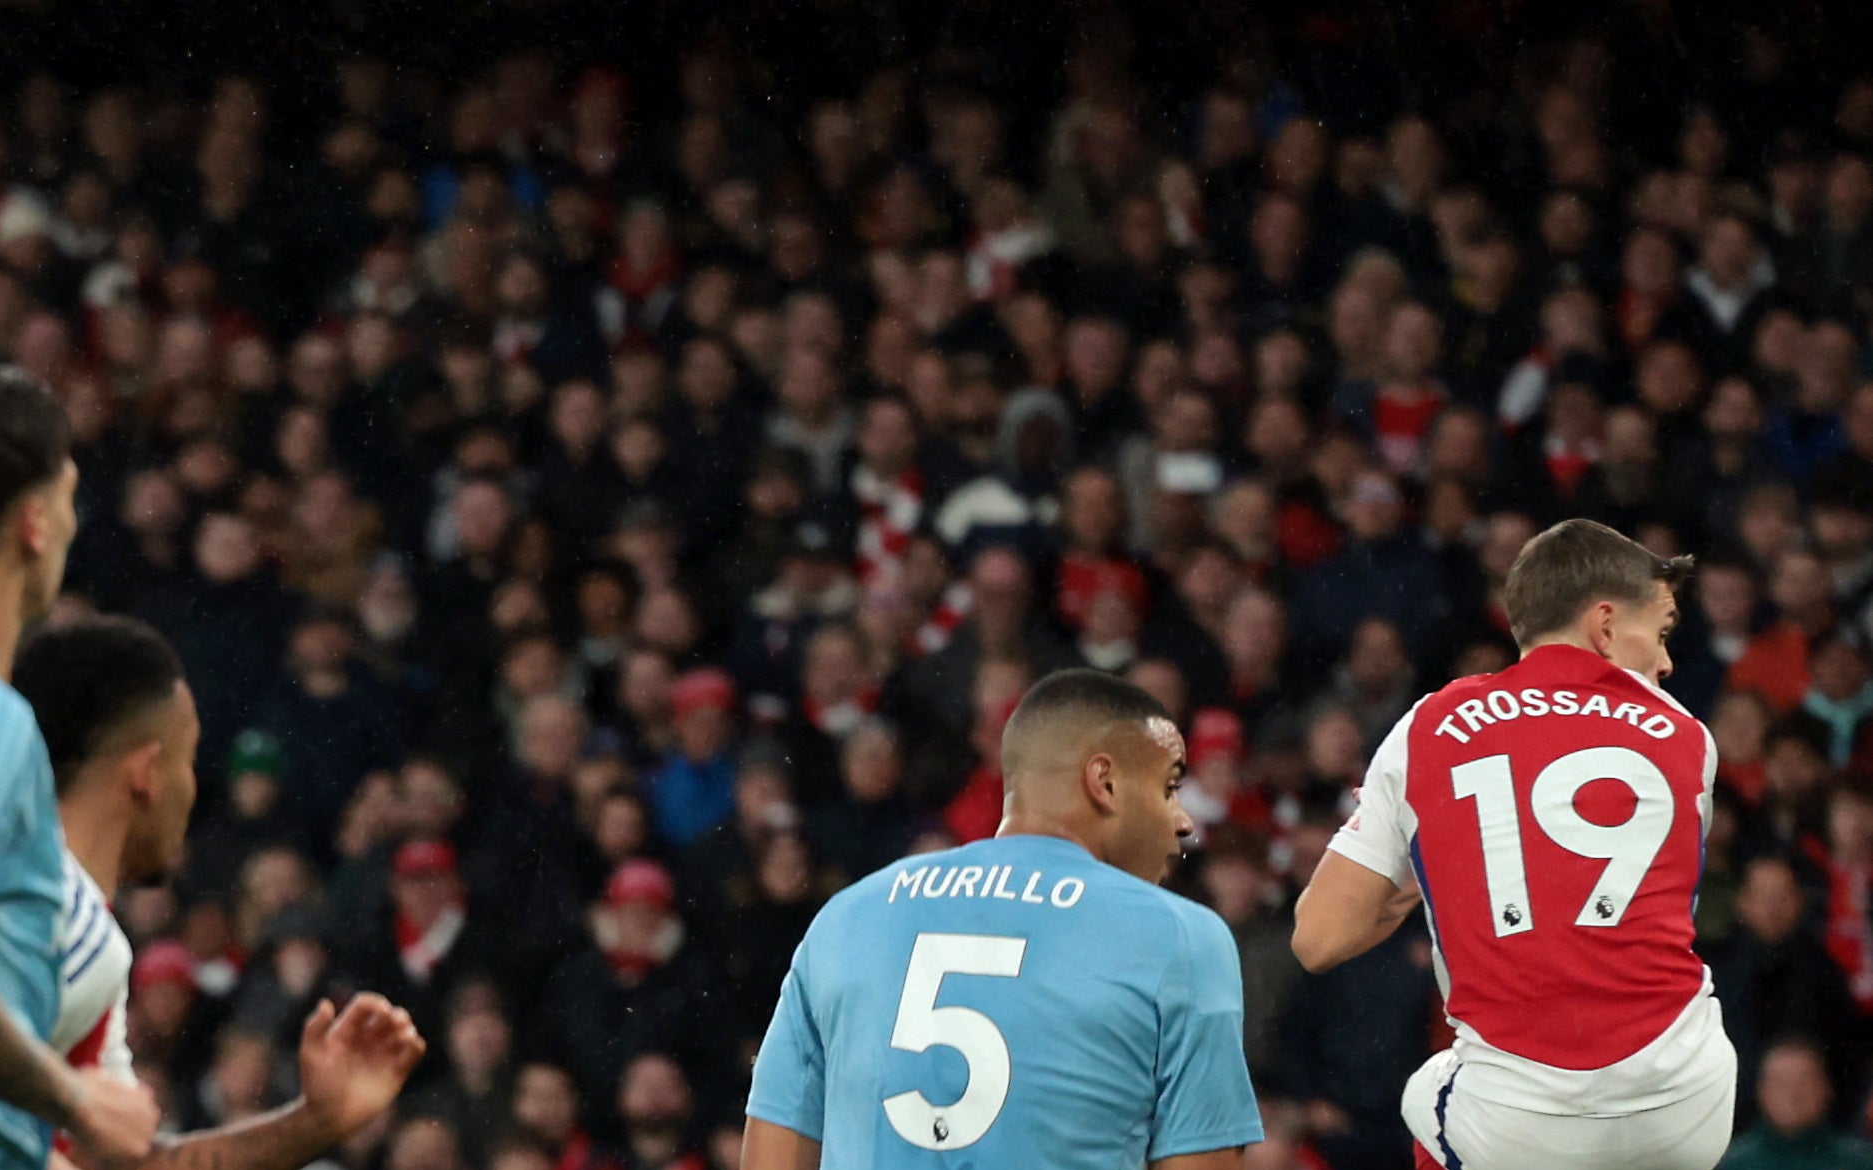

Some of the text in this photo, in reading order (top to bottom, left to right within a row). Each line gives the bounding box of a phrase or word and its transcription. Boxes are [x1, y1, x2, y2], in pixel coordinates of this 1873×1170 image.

[1434, 688, 1676, 745] TROSSARD
[888, 864, 1087, 909] MURILLO
[1451, 746, 1675, 938] 19
[883, 932, 1027, 1152] 5
